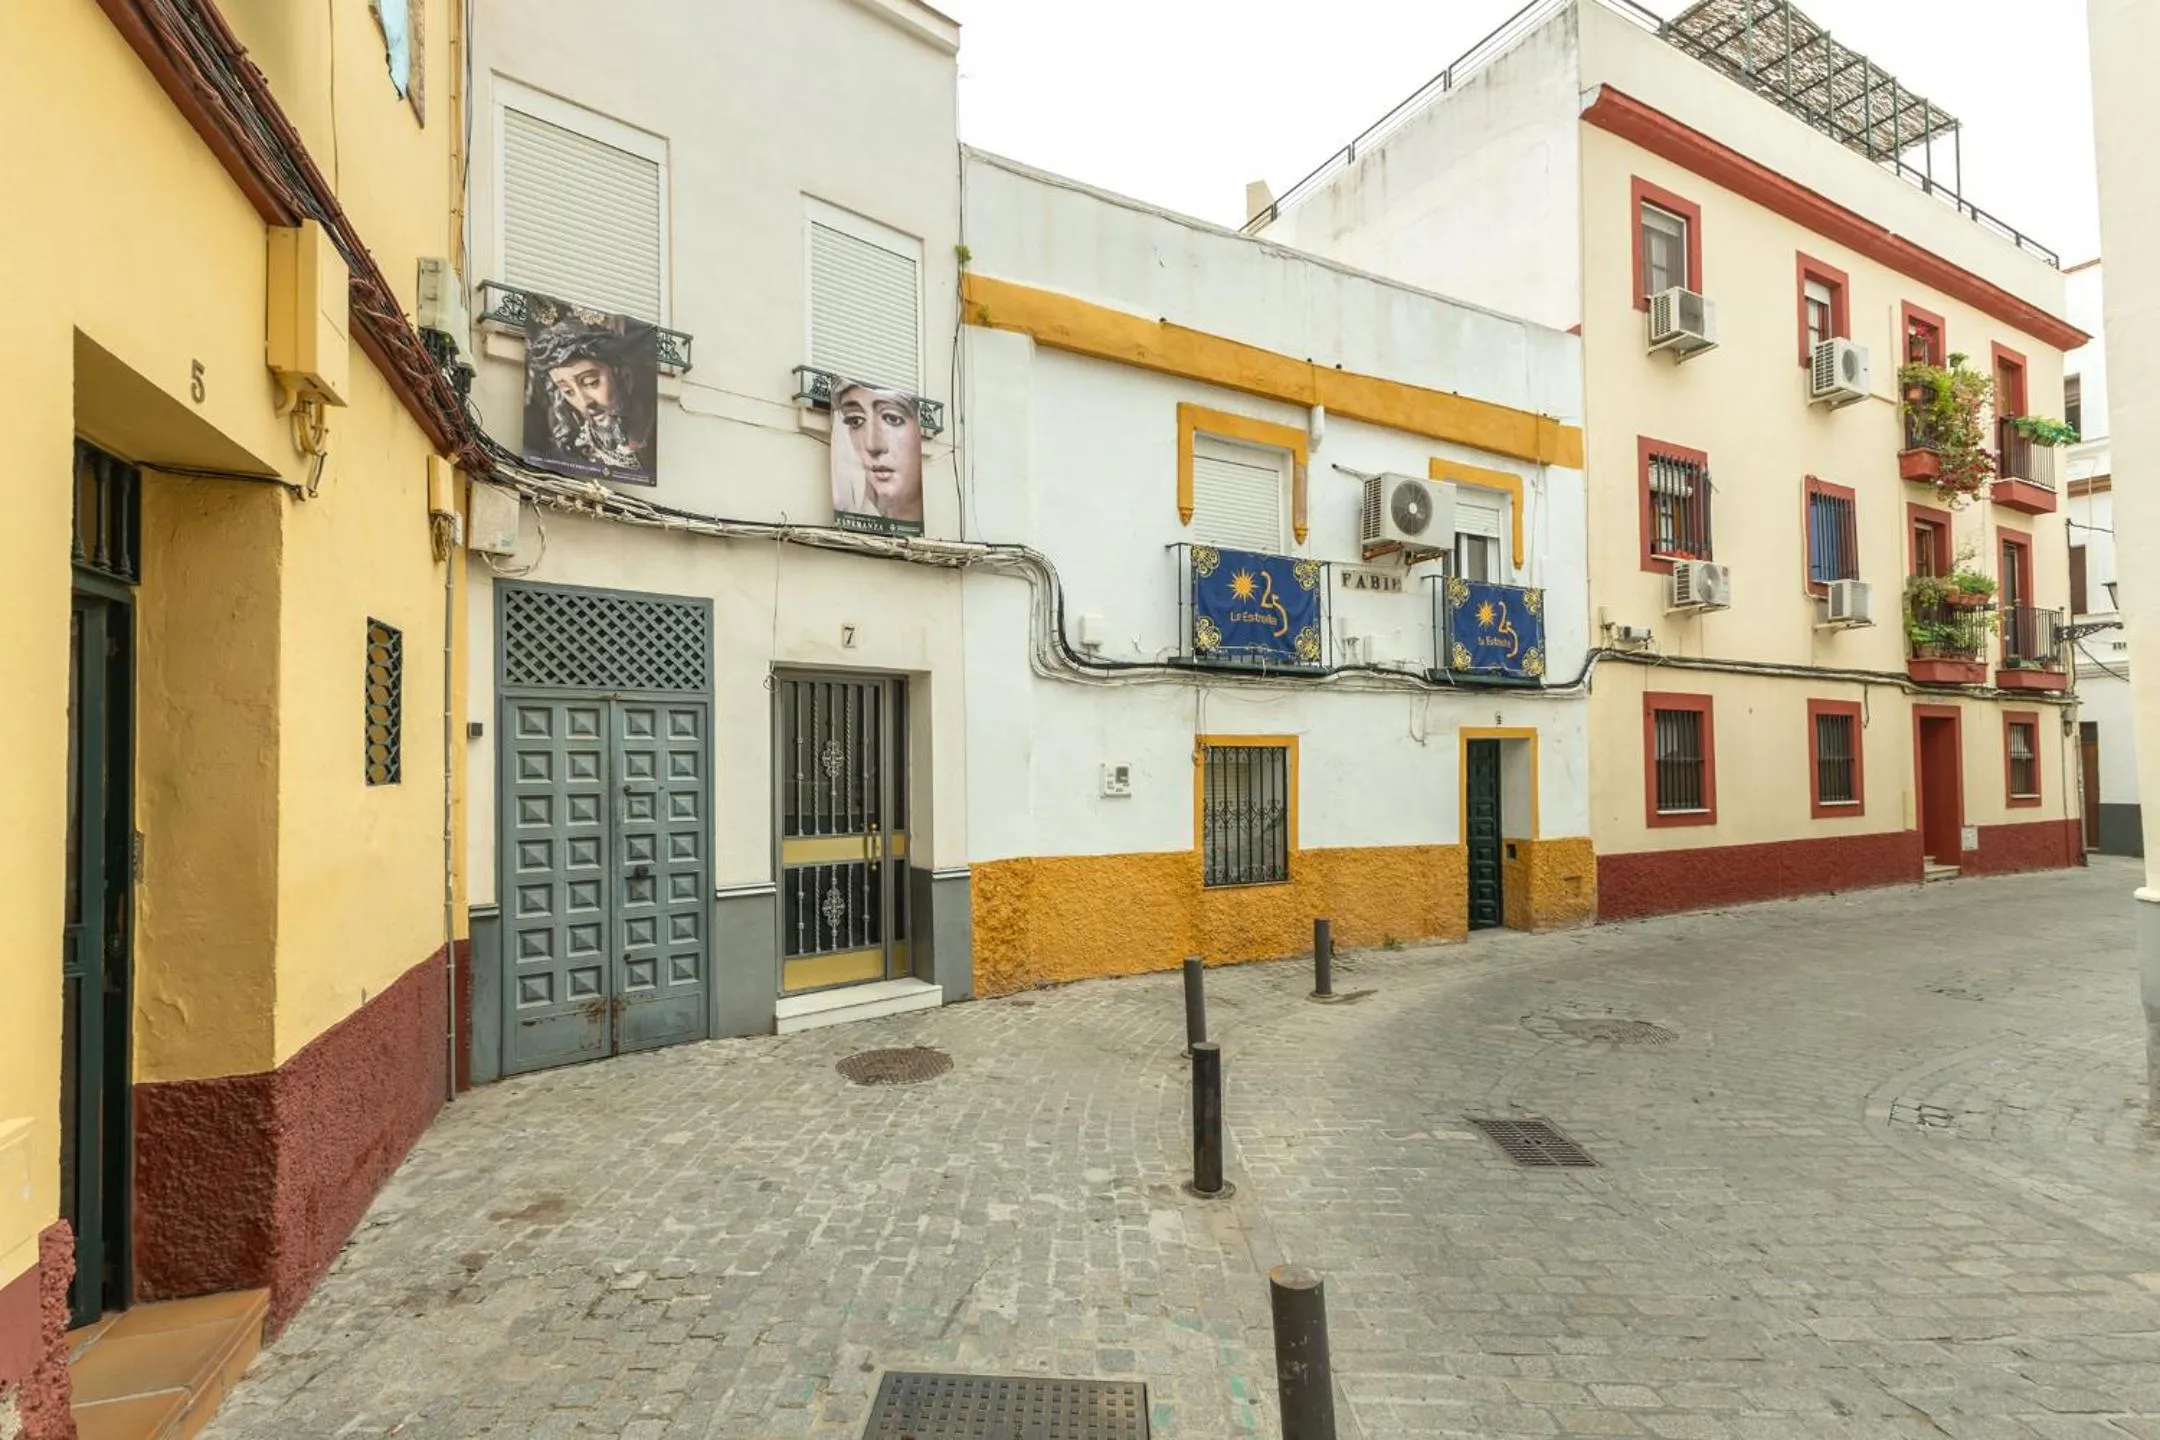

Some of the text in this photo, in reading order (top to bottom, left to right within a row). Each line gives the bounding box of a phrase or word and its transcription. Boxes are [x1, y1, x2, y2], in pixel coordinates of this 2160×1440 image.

[191, 358, 206, 404] 5
[1260, 570, 1289, 638] 25
[844, 626, 856, 645] 7
